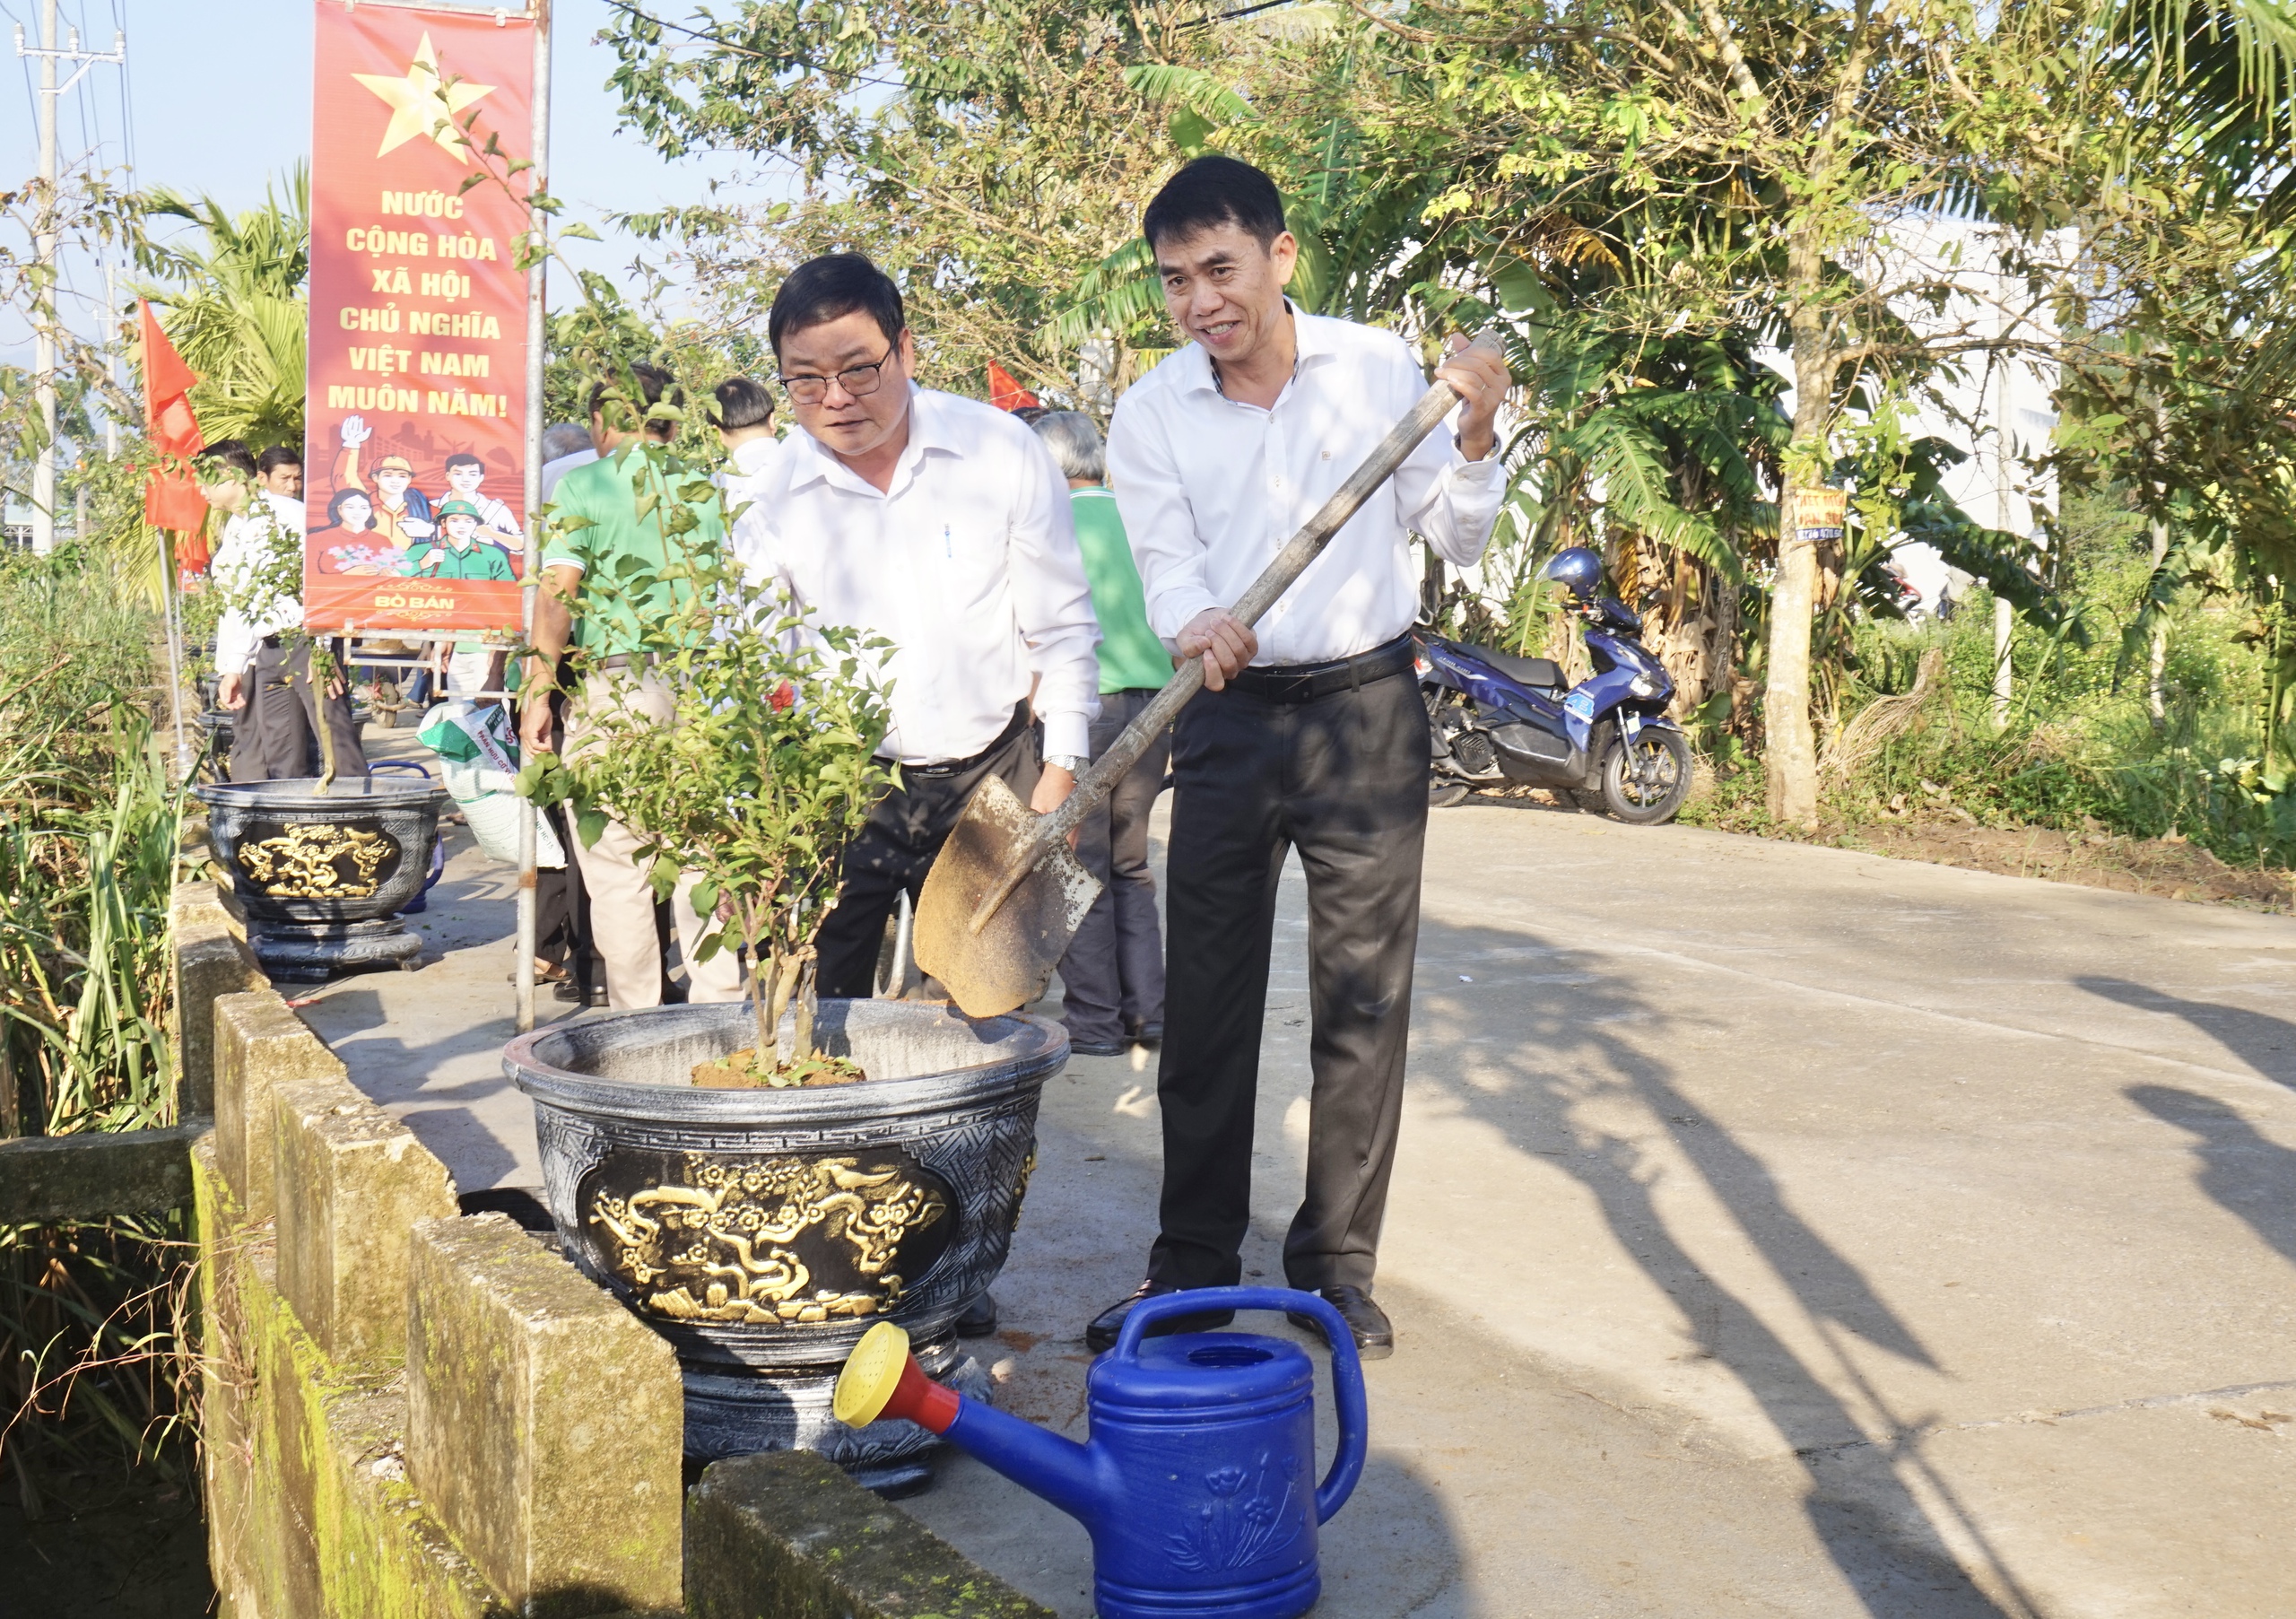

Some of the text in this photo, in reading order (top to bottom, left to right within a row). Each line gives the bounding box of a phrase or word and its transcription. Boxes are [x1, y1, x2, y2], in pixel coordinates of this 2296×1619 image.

[382, 189, 465, 219] NƯỚC
[346, 224, 497, 261] CỘNG HÒA
[371, 266, 471, 303] XÃ HỘI
[339, 301, 501, 340] CHỦ NGHĨA
[348, 344, 490, 378] VIỆT NAM
[327, 384, 509, 418] MUÔN NĂM!
